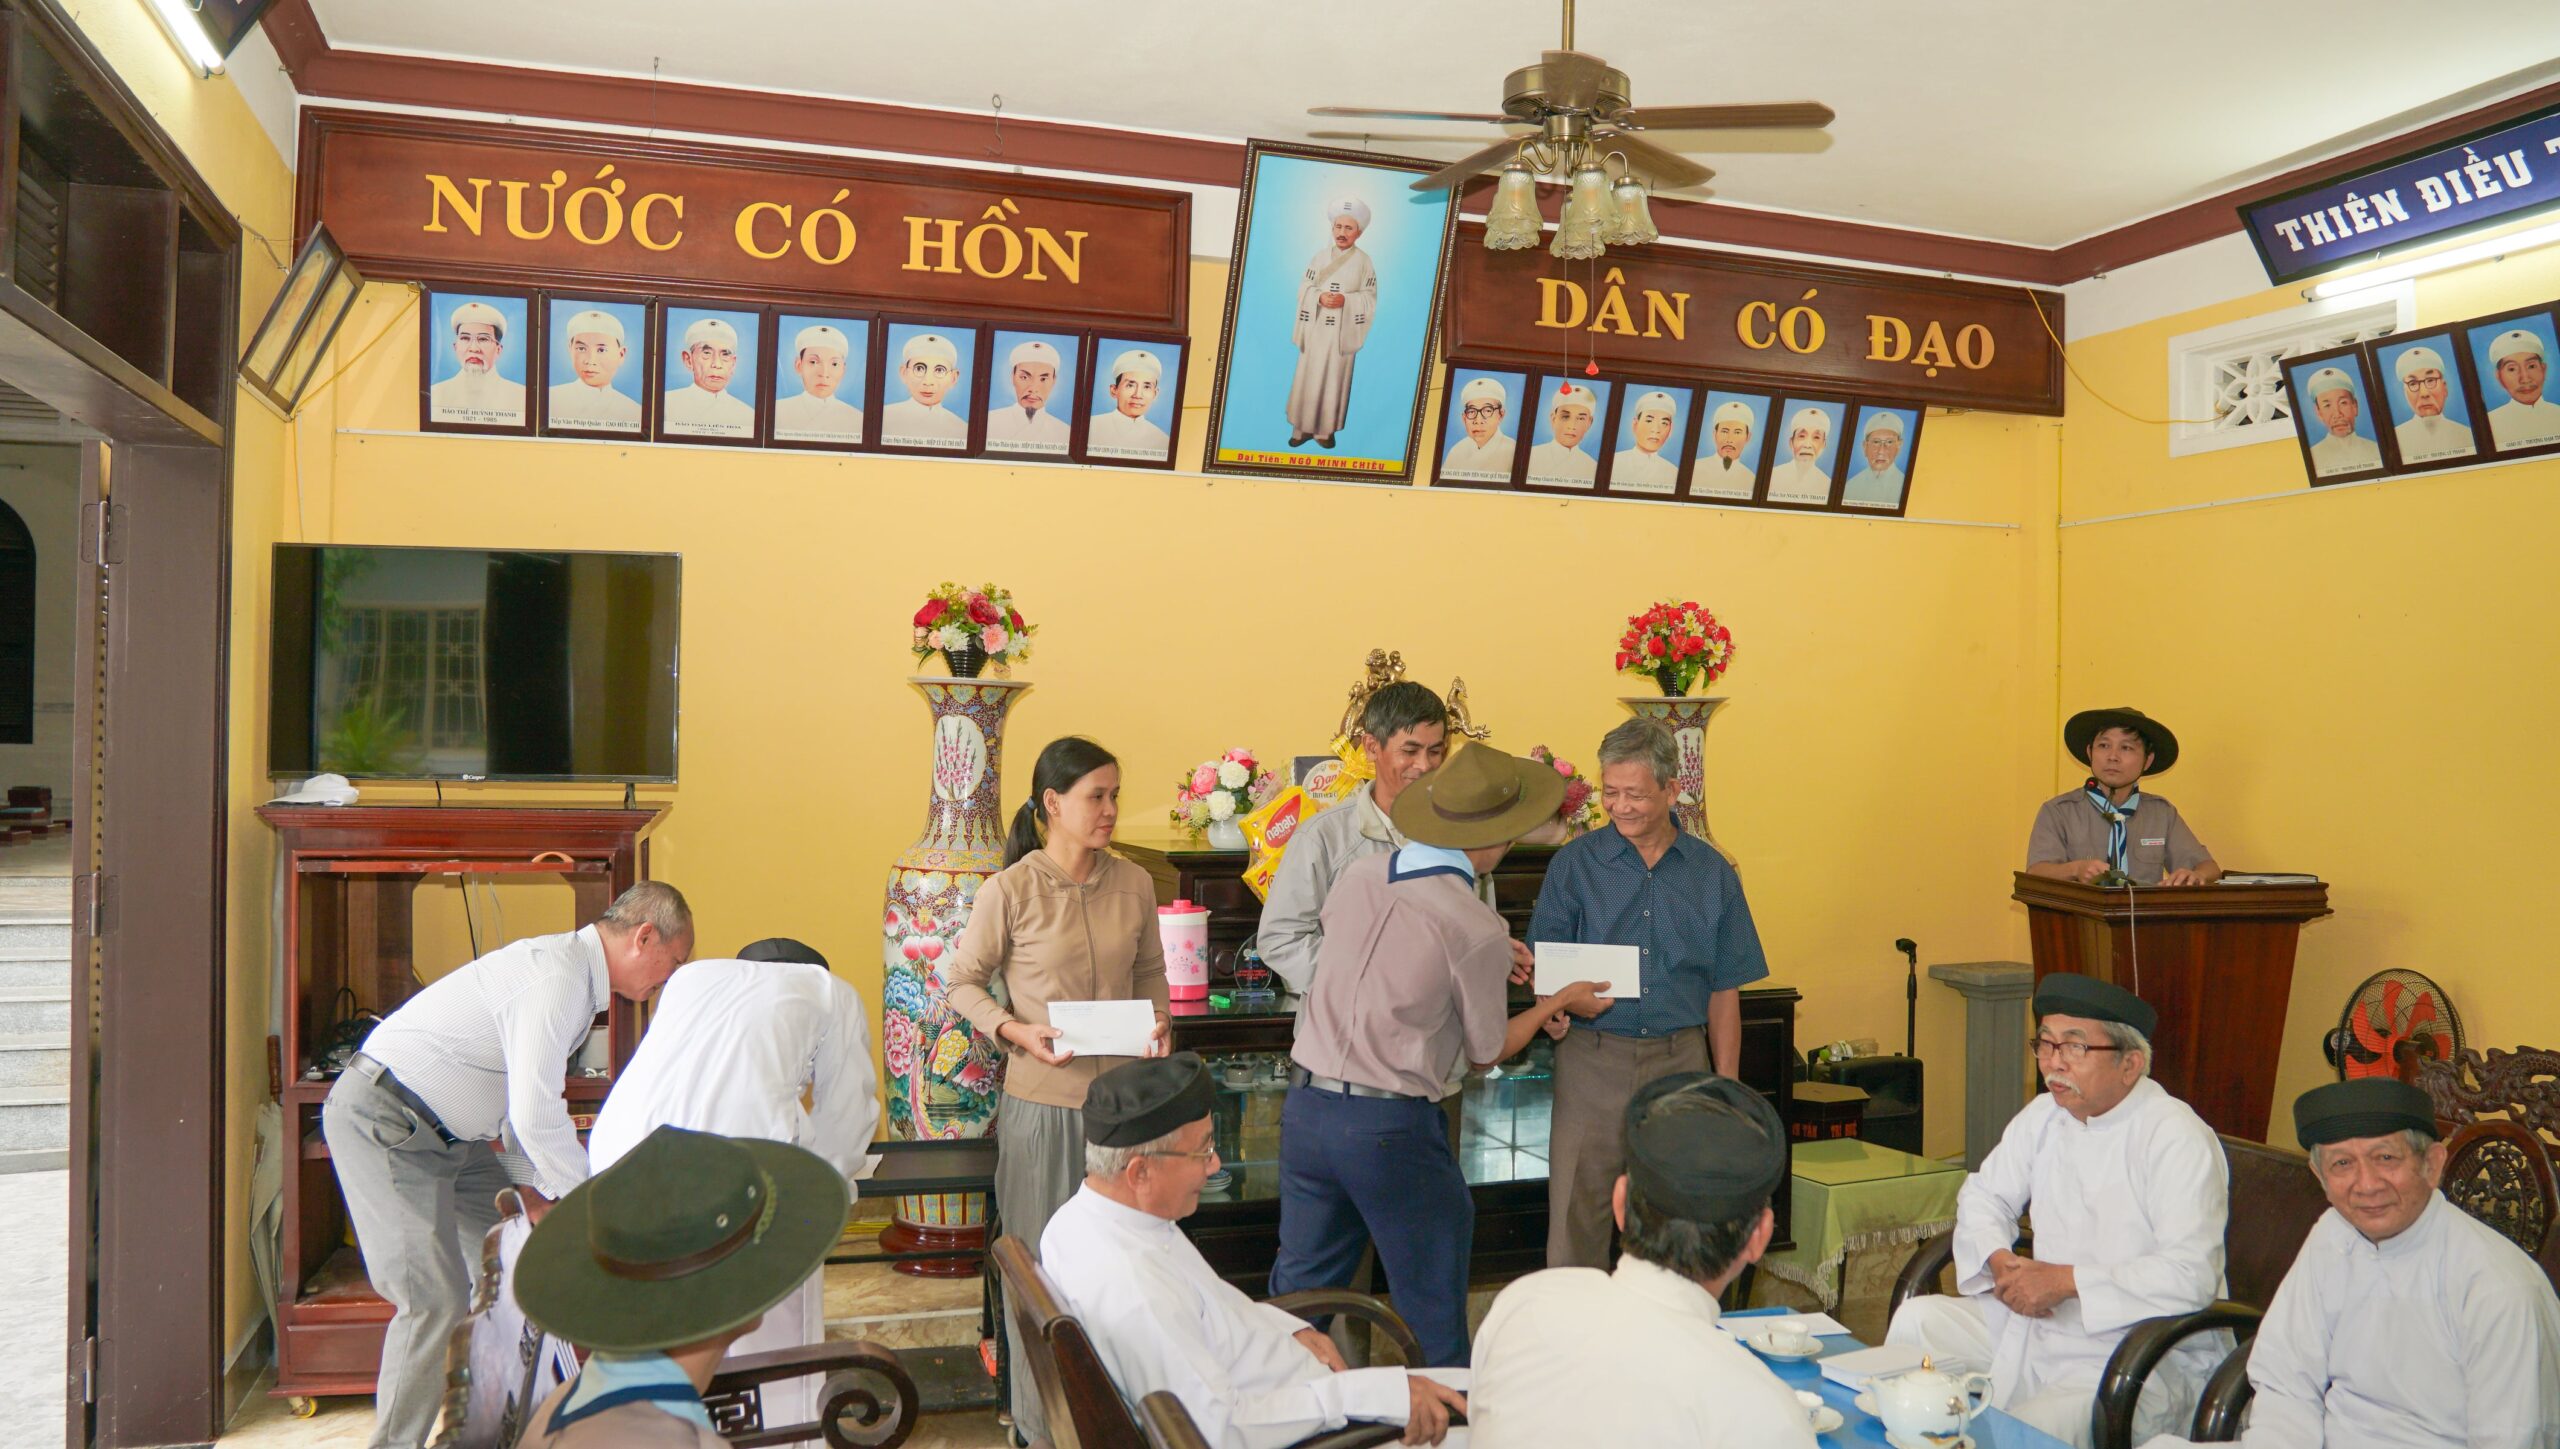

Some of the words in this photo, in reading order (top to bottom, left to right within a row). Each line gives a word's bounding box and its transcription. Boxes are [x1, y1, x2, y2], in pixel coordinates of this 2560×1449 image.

[423, 164, 684, 251] NƯỚC
[735, 188, 857, 266] CÓ
[902, 198, 1089, 284] HỒN
[2274, 189, 2410, 252] THIÊN
[2415, 147, 2533, 213] ĐIỀU
[1534, 267, 1690, 340] DÂN
[1736, 288, 1826, 354] CÓ
[1865, 314, 1996, 378] ĐẠO
[1317, 458, 1348, 468] MINH
[1266, 814, 1296, 841] nabati
